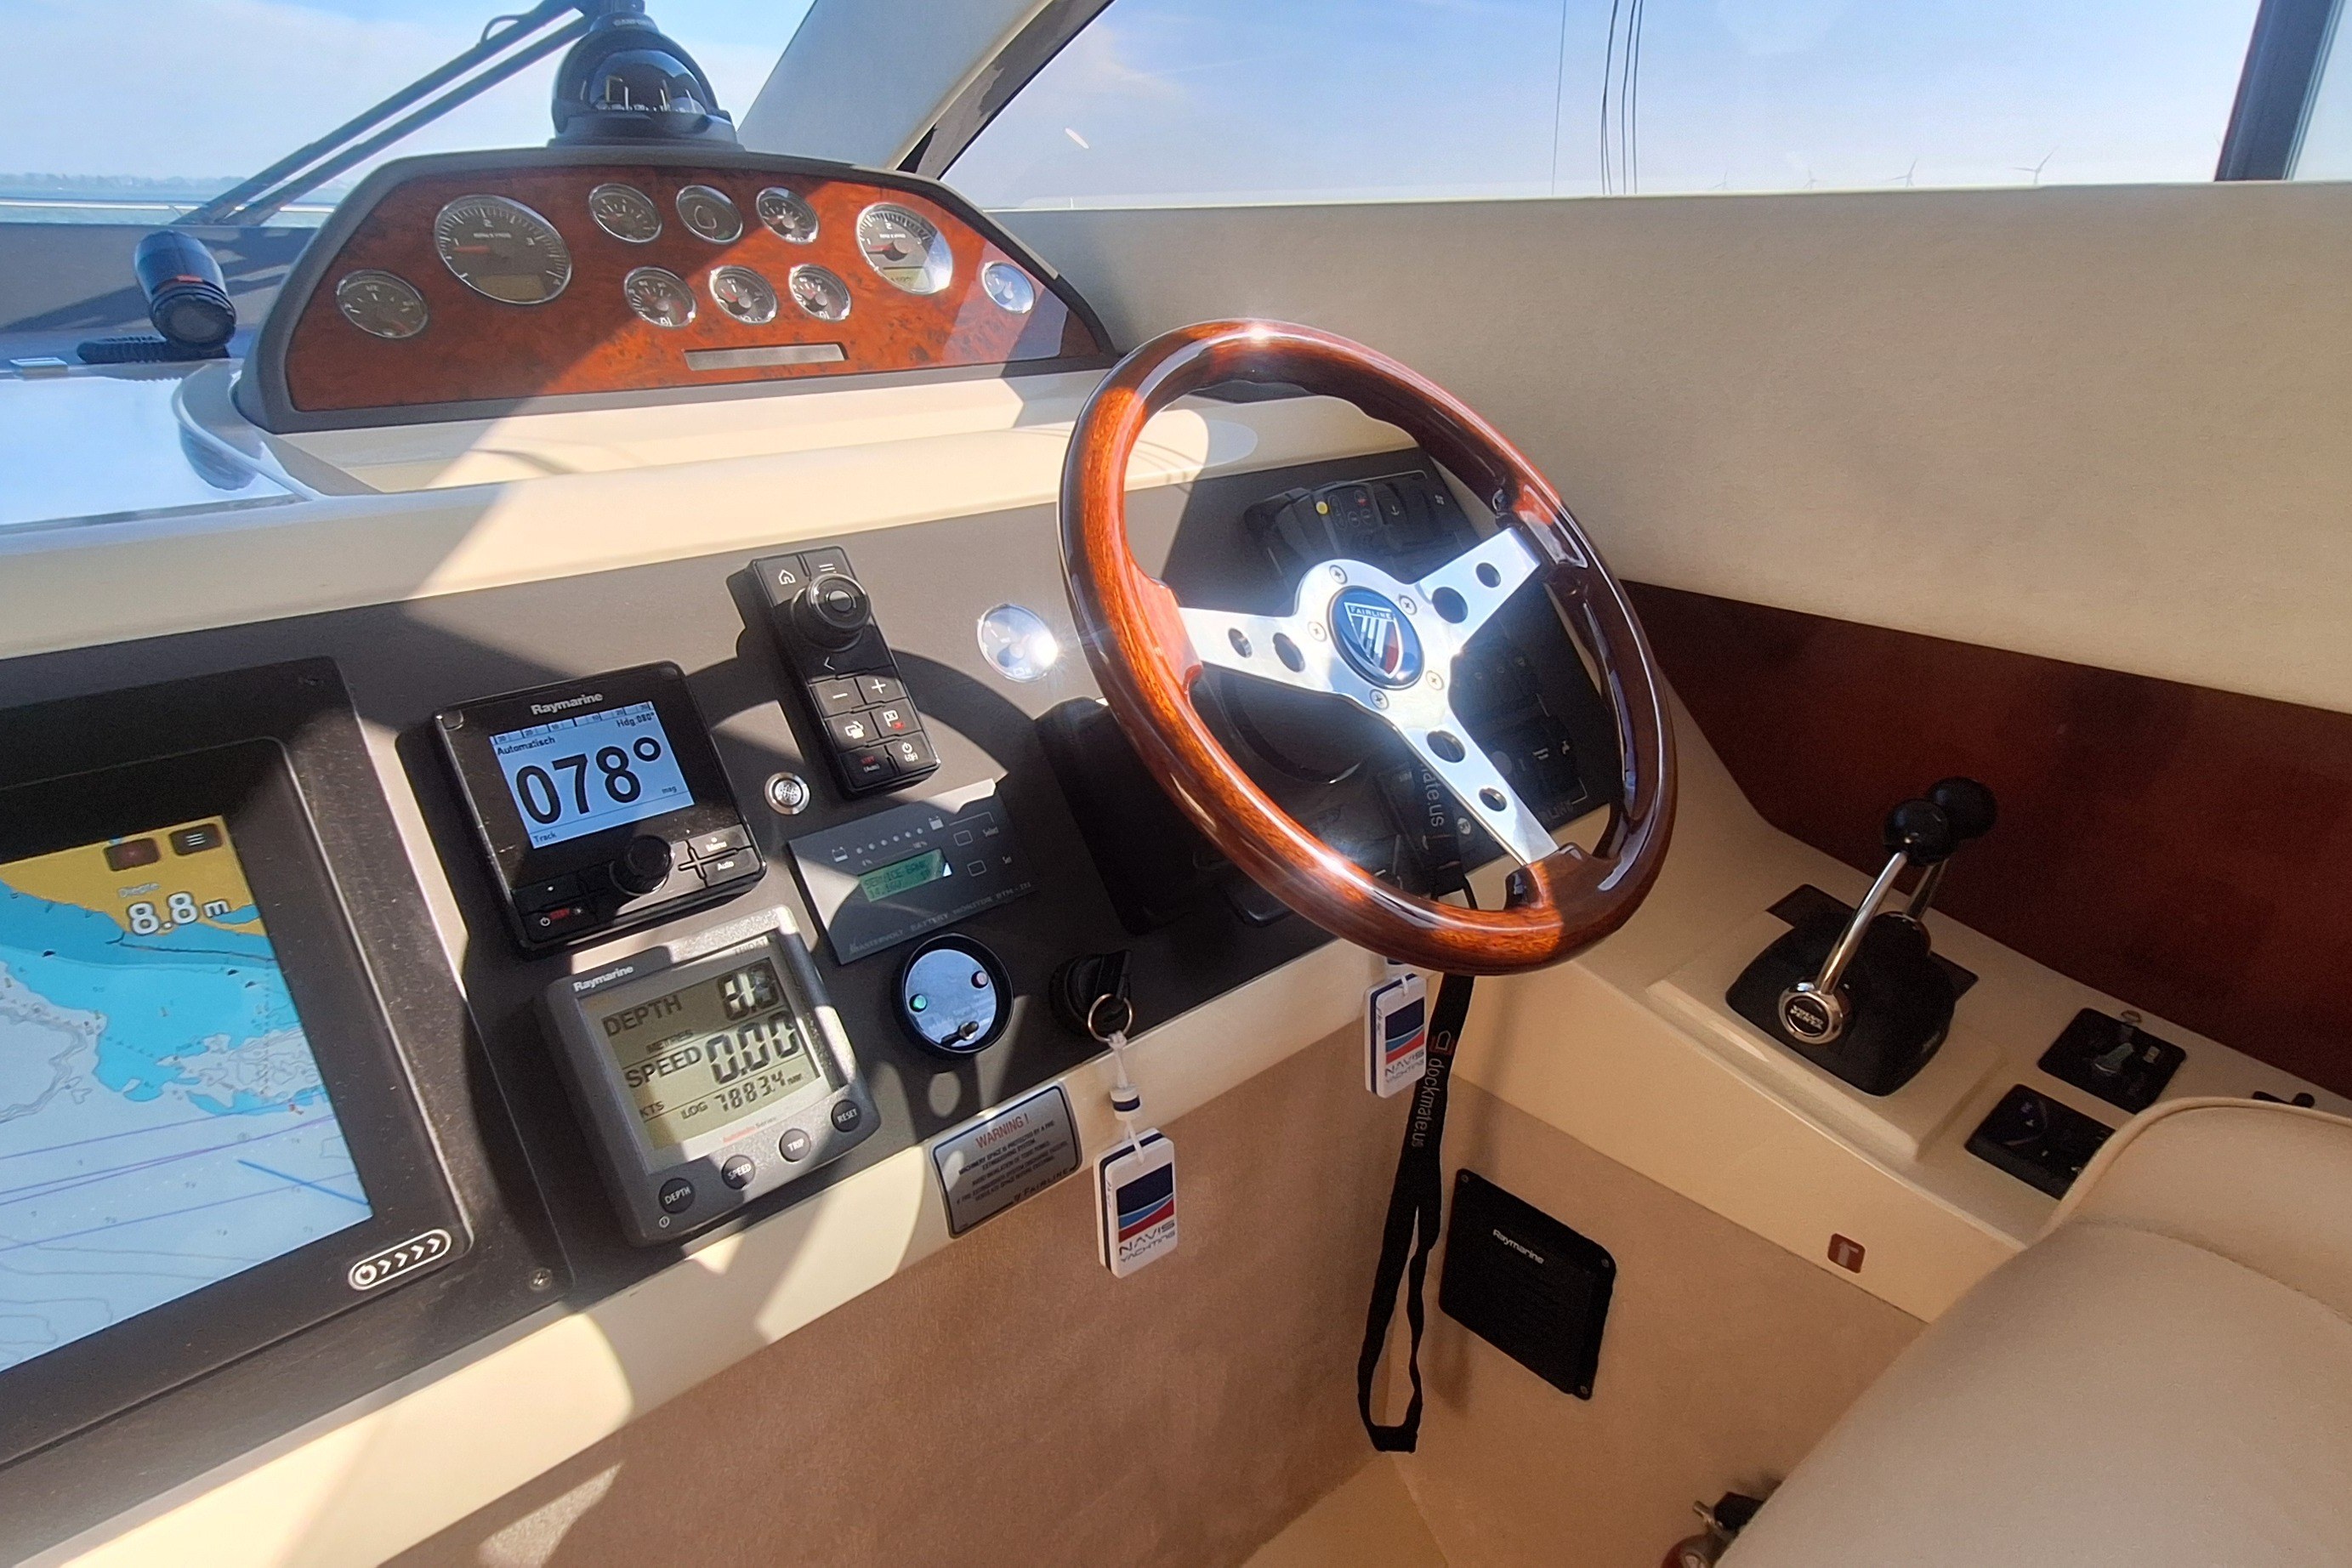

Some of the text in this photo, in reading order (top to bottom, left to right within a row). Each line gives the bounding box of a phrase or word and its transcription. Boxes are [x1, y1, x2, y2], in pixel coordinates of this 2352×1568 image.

[1349, 605, 1392, 620] FAIRLINE
[531, 692, 604, 715] Raymarine
[497, 736, 556, 756] Automatisch
[515, 736, 662, 825] 078°
[662, 786, 678, 794] mag
[533, 832, 557, 843] Track
[705, 841, 728, 853] Menu
[717, 861, 735, 872] Auto
[128, 892, 230, 935] 8.8 m
[572, 965, 634, 992] Raymarine
[602, 995, 683, 1037] DEPTH
[624, 1010, 800, 1088] SPEED 0.00
[645, 1029, 695, 1054] METRES
[1384, 1048, 1425, 1077] NAVIS
[639, 1100, 665, 1118] KTS
[681, 1102, 708, 1120] LOG
[1412, 1057, 1445, 1148] dockmate.us
[837, 1108, 858, 1124] RESET
[787, 1138, 805, 1152] TRIP
[728, 1163, 752, 1180] SPEED
[664, 1186, 691, 1205] DEPTH
[1118, 1219, 1175, 1256] NAVIS
[1121, 1230, 1176, 1263] YACHTING
[1492, 1229, 1545, 1264] Raymarine
